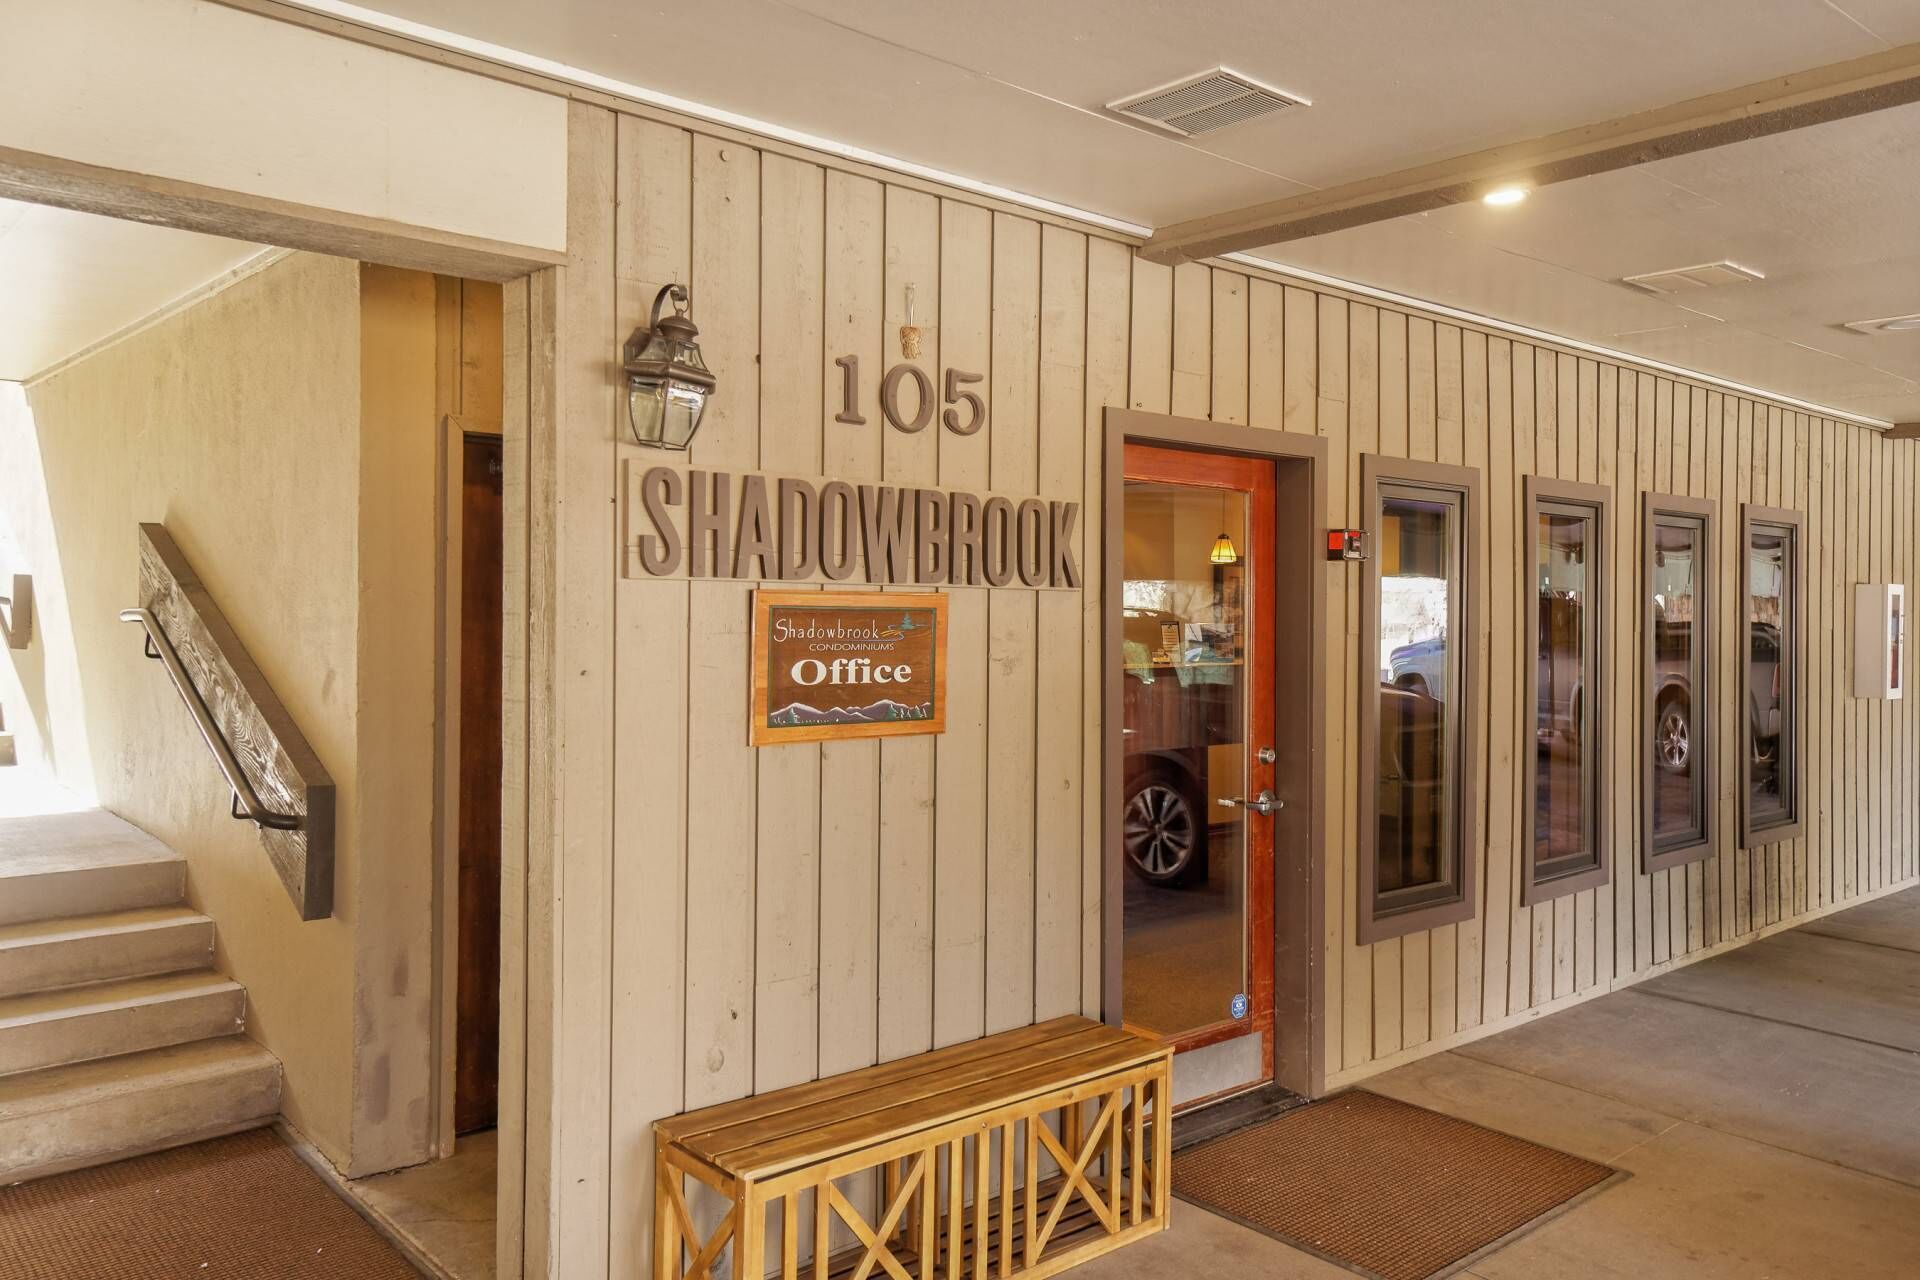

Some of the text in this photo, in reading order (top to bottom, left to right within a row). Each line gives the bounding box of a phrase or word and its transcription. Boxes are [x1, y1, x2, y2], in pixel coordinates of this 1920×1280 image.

[835, 354, 986, 436] 105
[639, 466, 1082, 588] SHADOWBROOK
[773, 618, 879, 642] Shadowbrook
[808, 643, 896, 652] CONDOMINIUMS
[791, 658, 913, 686] Office
